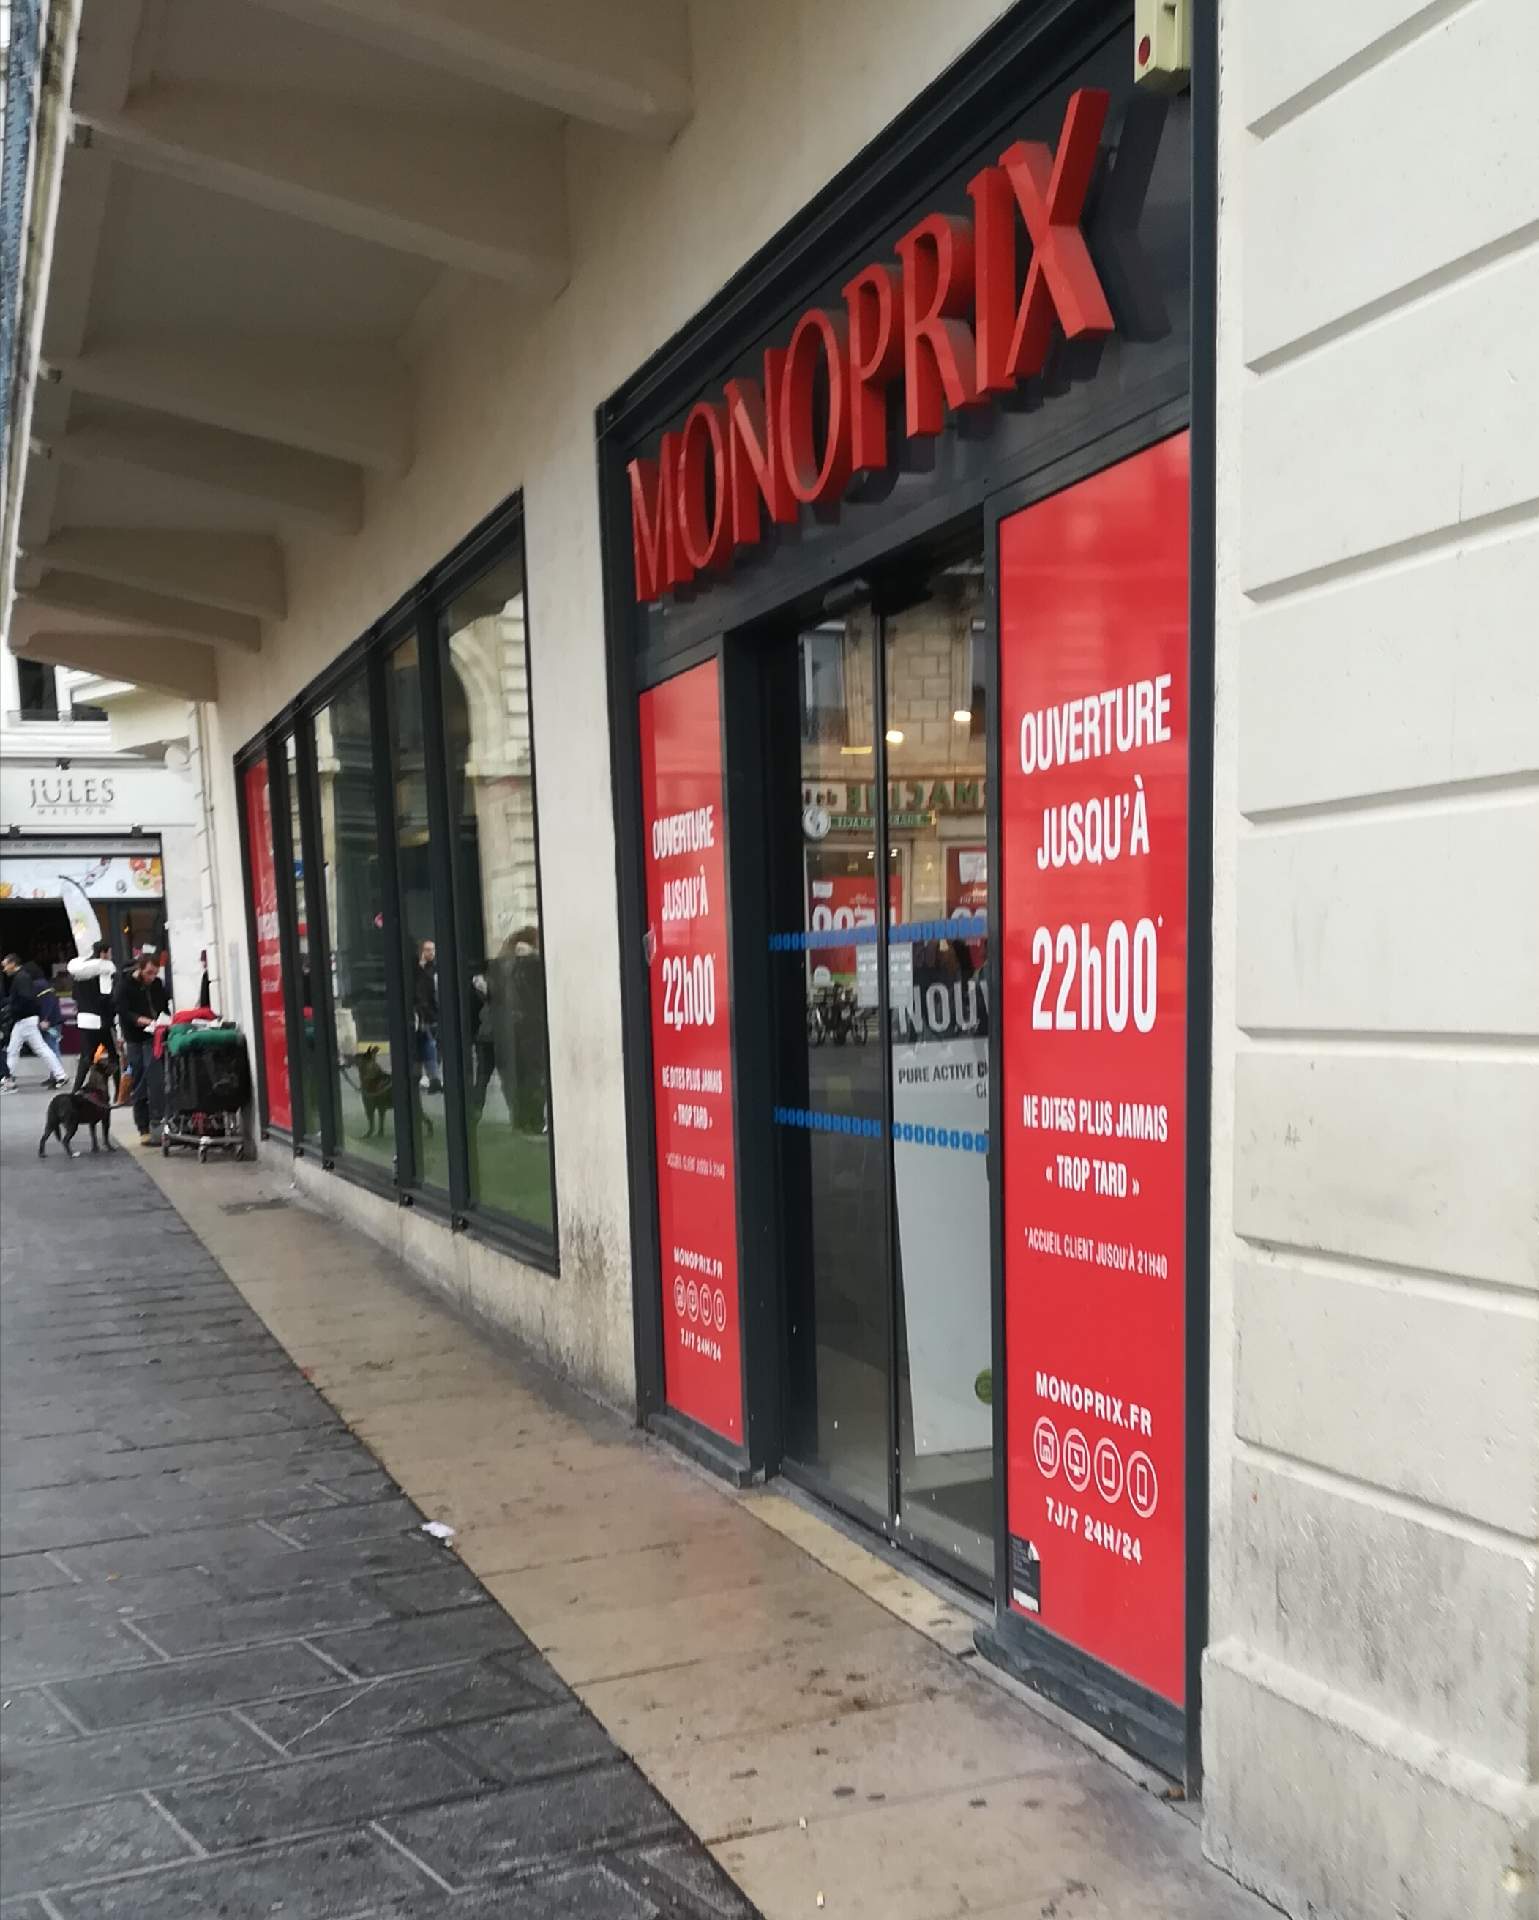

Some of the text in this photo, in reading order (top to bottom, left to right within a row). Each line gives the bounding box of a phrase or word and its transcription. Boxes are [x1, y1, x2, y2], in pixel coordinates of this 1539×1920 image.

[627, 88, 1115, 603] MONOPRIX
[1020, 673, 1172, 775] OUVERTURE
[30, 777, 115, 808] JULES
[652, 804, 715, 860] OUVERTURE
[1037, 774, 1150, 870] JUSQU'À
[898, 1067, 929, 1084] PURE
[932, 1063, 974, 1081] ACTIVE
[1023, 1094, 1169, 1143] NE DITES PLUS JAMAIS
[1056, 1154, 1091, 1192] TROP
[1093, 1159, 1127, 1198] TARD
[673, 1246, 723, 1281] MONOPRIX.FR
[1063, 1233, 1095, 1264] CLIENT
[697, 1335, 722, 1362] 24H/24
[1035, 1371, 1152, 1437] MONOPRIX.FR
[1045, 1496, 1142, 1565] 7J/7 24H/24
